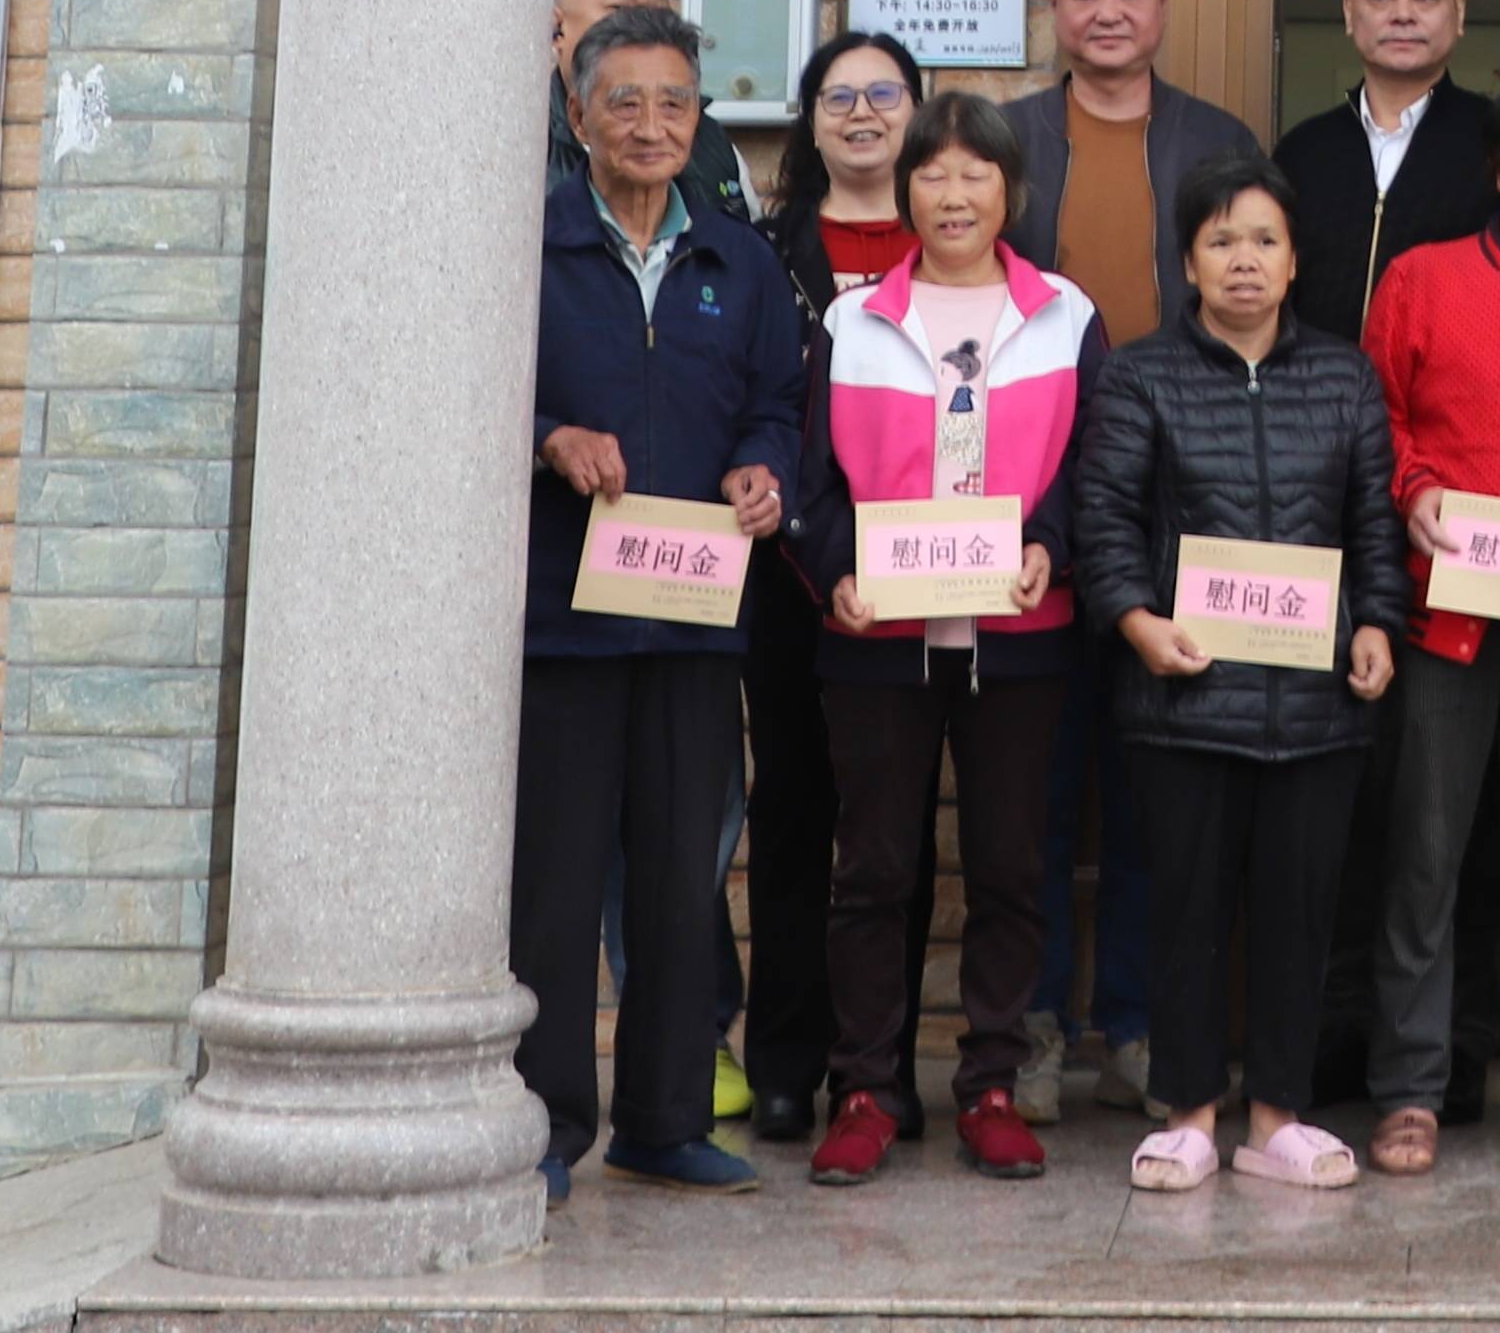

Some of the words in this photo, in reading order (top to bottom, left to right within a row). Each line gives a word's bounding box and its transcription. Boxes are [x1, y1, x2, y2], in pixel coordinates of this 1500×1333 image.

[893, 18, 979, 33] 全年免费开放
[614, 534, 721, 579] 慰问金
[890, 533, 996, 570] 慰问金
[1204, 576, 1308, 621] 慰问金
